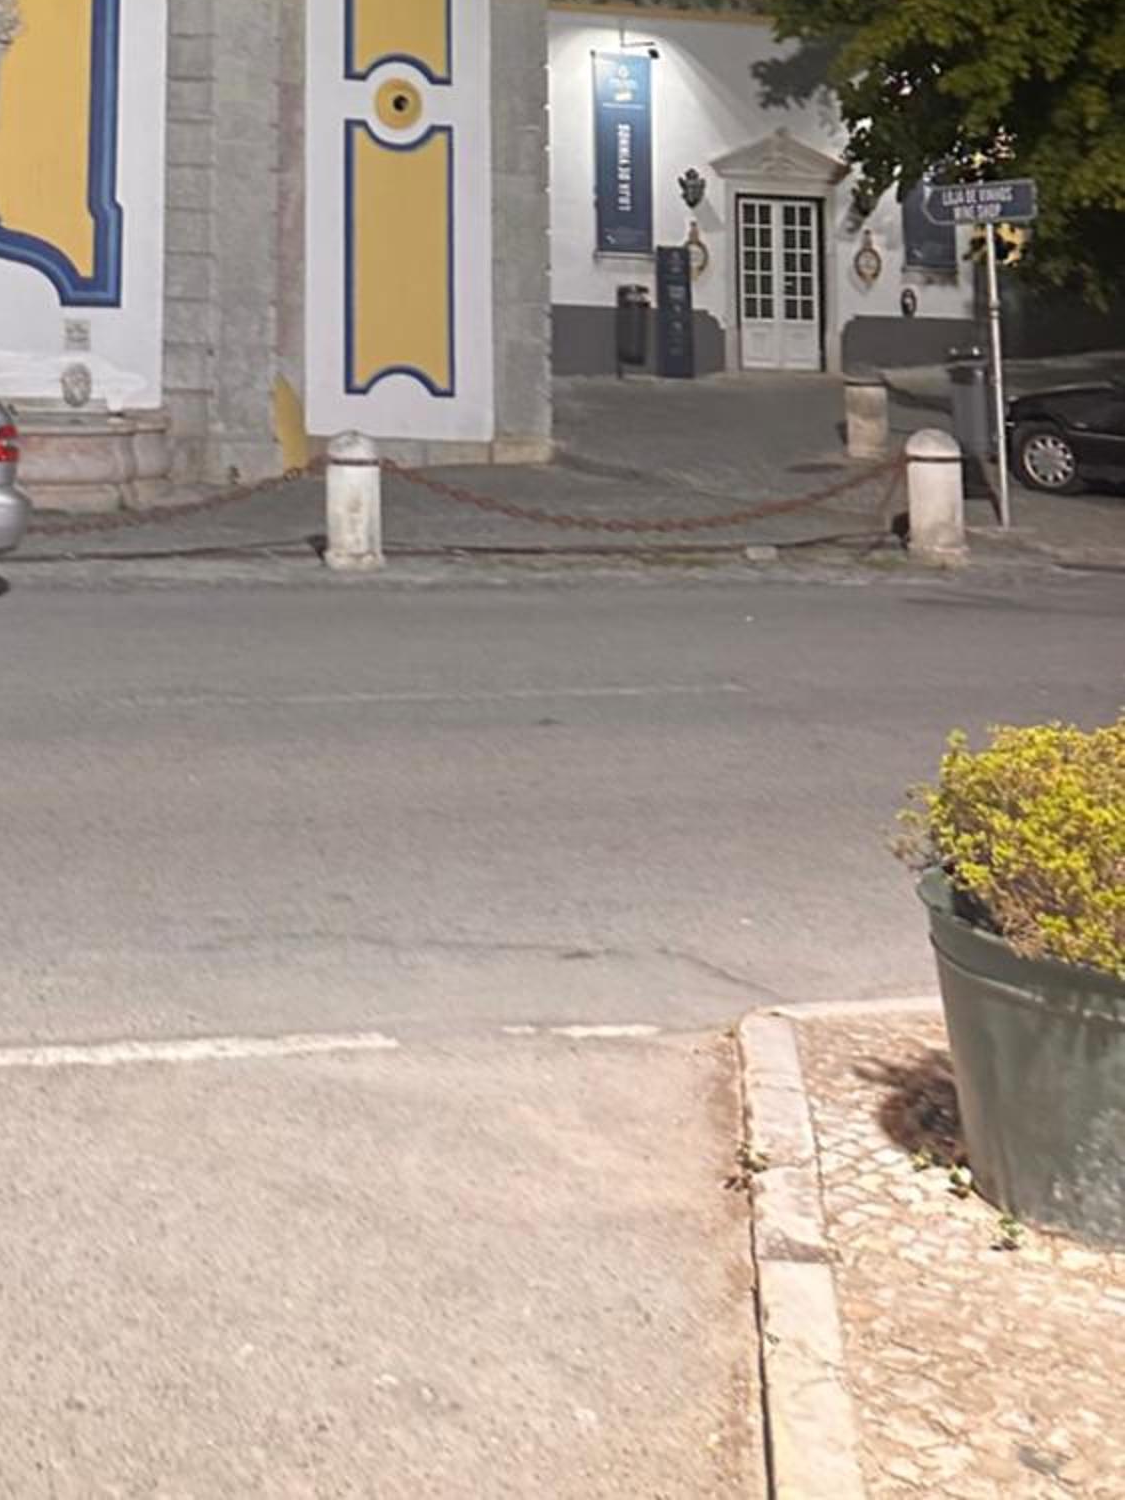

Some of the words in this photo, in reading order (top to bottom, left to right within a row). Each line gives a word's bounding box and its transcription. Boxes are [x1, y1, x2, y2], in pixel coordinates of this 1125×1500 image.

[942, 188, 964, 206] LOJA
[966, 188, 977, 204] DE
[979, 186, 1014, 202] VINHOS
[954, 204, 976, 220] WINE
[977, 203, 1002, 218] SHOP
